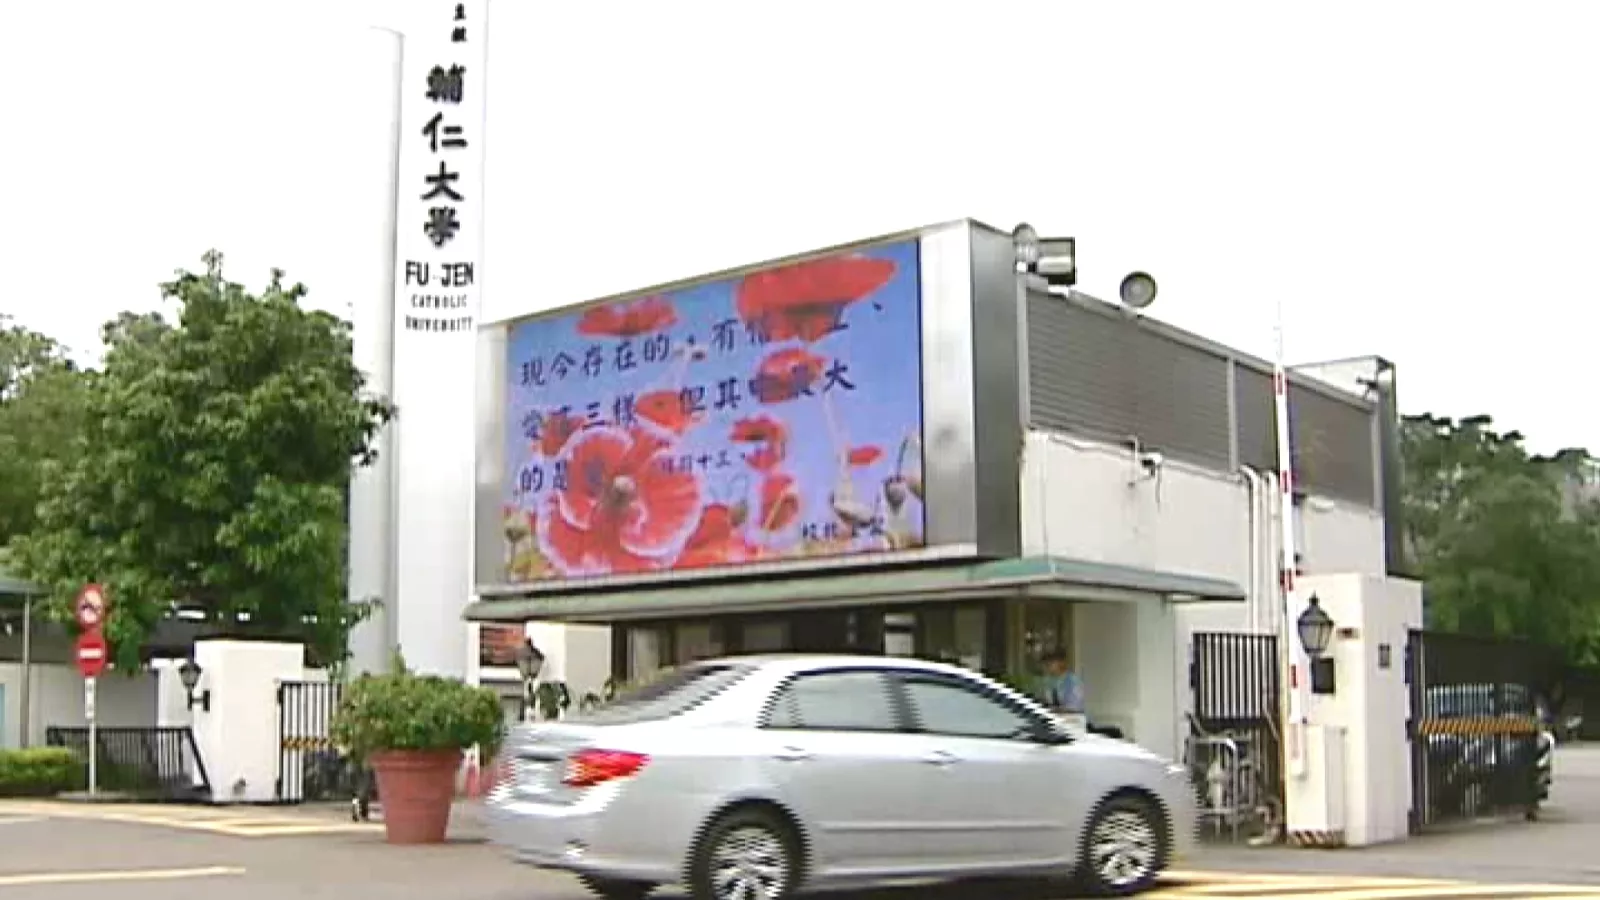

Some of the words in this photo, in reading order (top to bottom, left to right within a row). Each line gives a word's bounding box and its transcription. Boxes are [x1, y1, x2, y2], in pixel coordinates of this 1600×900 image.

[420, 63, 468, 249] 輔仁大學
[405, 260, 429, 287] FU
[441, 262, 474, 288] JEN
